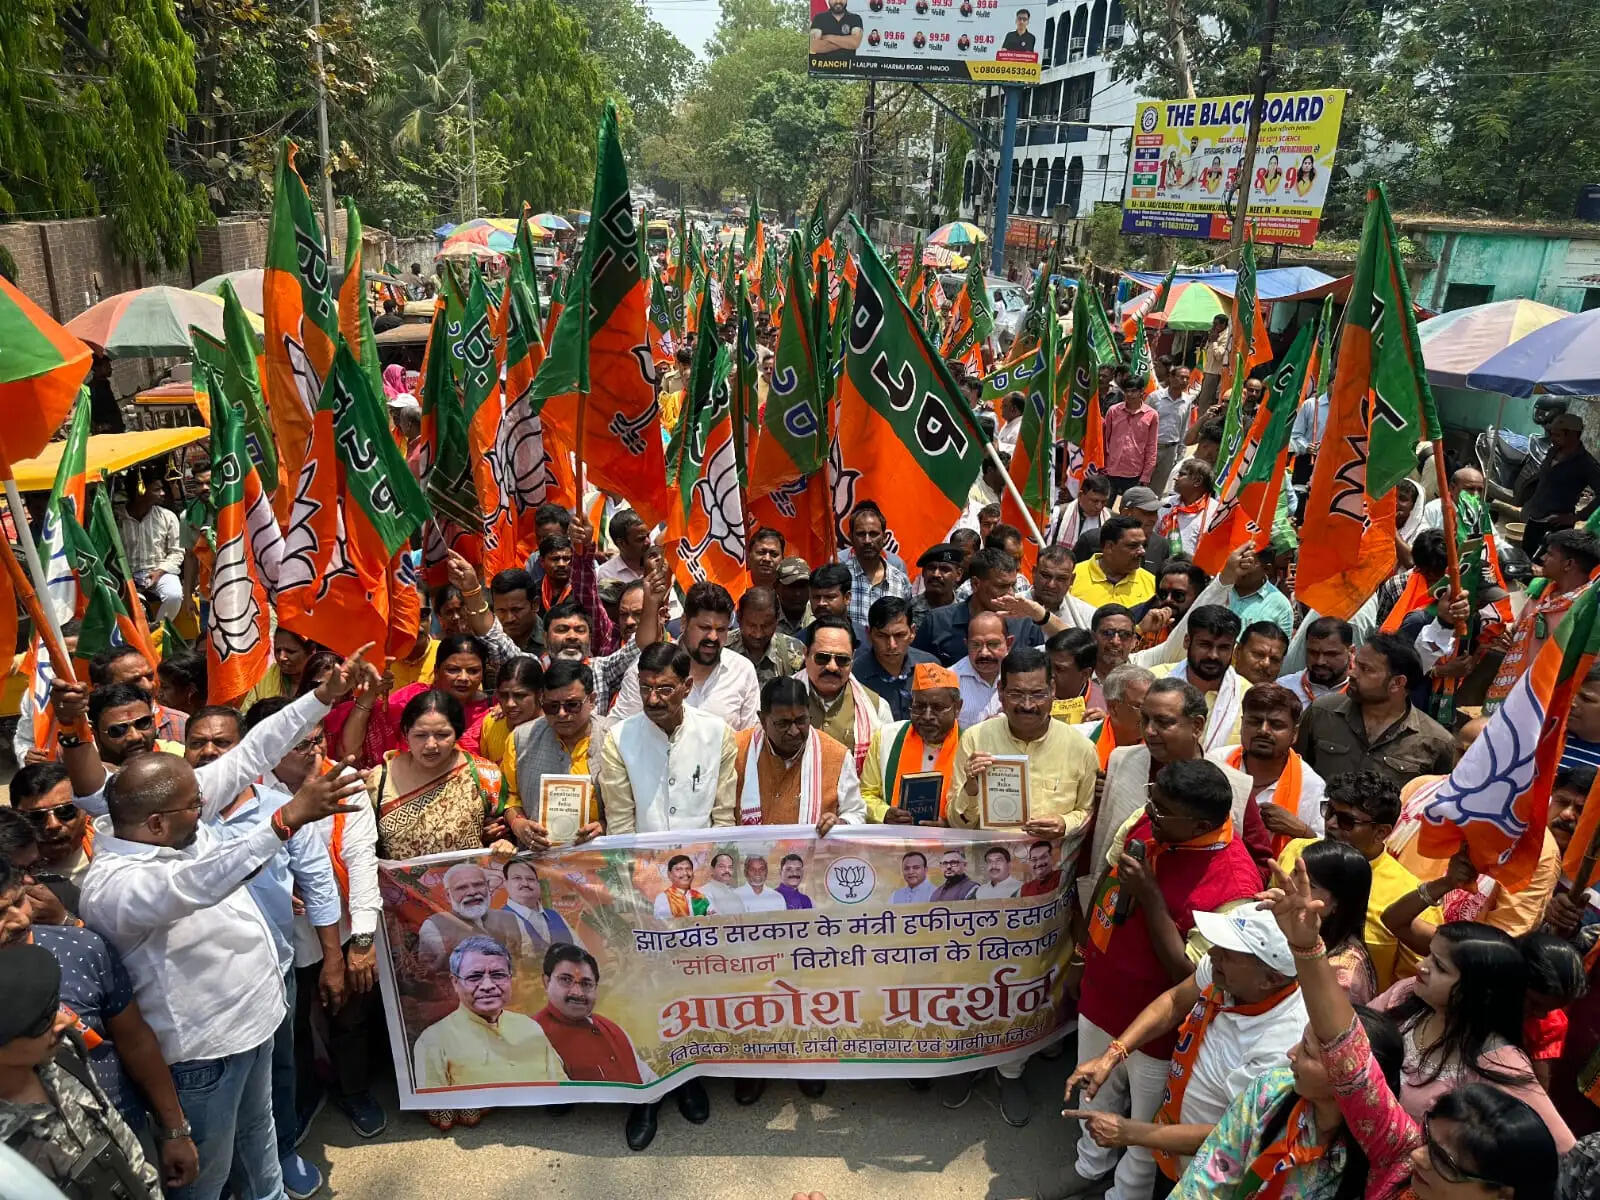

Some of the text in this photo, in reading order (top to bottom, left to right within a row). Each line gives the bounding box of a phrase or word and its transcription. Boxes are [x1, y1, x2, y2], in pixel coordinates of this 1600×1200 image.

[929, 33, 950, 42] 99.58
[974, 35, 994, 44] 99.43
[818, 60, 848, 68] RANCHI
[1166, 104, 1196, 127] THE
[1284, 167, 1297, 189] 9
[633, 922, 719, 952] झारखंड
[723, 920, 810, 943] सरकार
[814, 914, 843, 937] के
[848, 910, 897, 936] मंत्री
[901, 906, 1000, 938] हफीजुल
[1004, 901, 1058, 930] हसन
[672, 929, 1061, 976] "संविधान" विरोधी बयान के खिलाफ
[661, 966, 1056, 1039] आक्रोश प्रदर्शन
[669, 1040, 730, 1065] निवेदक
[804, 1037, 839, 1054] रांची
[842, 1038, 913, 1054] महानगर
[916, 1034, 942, 1053] एवं
[946, 1033, 1002, 1053] ग्रामीण
